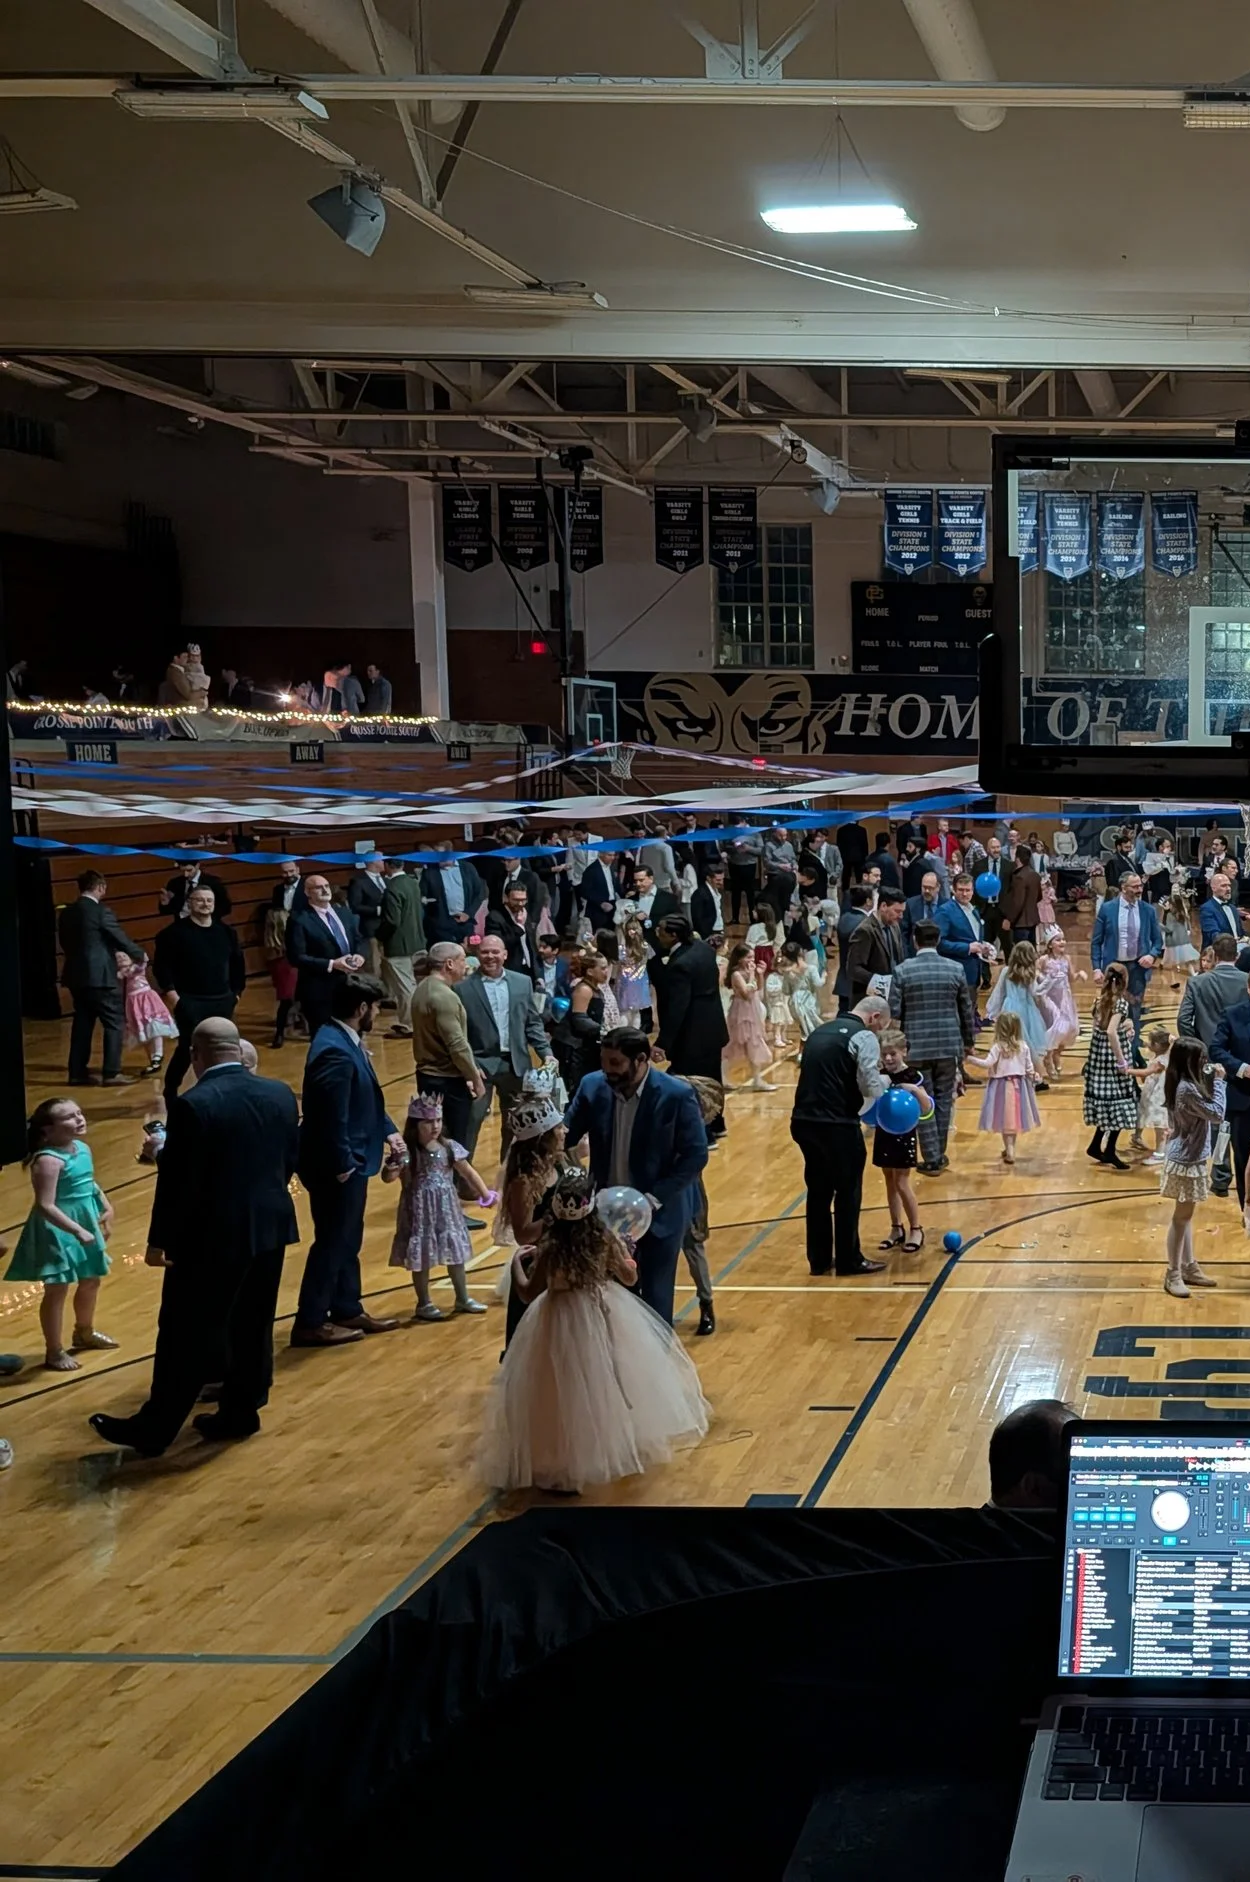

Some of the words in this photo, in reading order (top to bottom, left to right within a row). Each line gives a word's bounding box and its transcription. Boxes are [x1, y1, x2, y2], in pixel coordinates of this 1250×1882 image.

[865, 607, 890, 617] HOME
[964, 609, 993, 618] GUEST
[908, 640, 932, 648] PLAYER
[74, 744, 112, 762] HOME
[296, 746, 319, 761] AWAY
